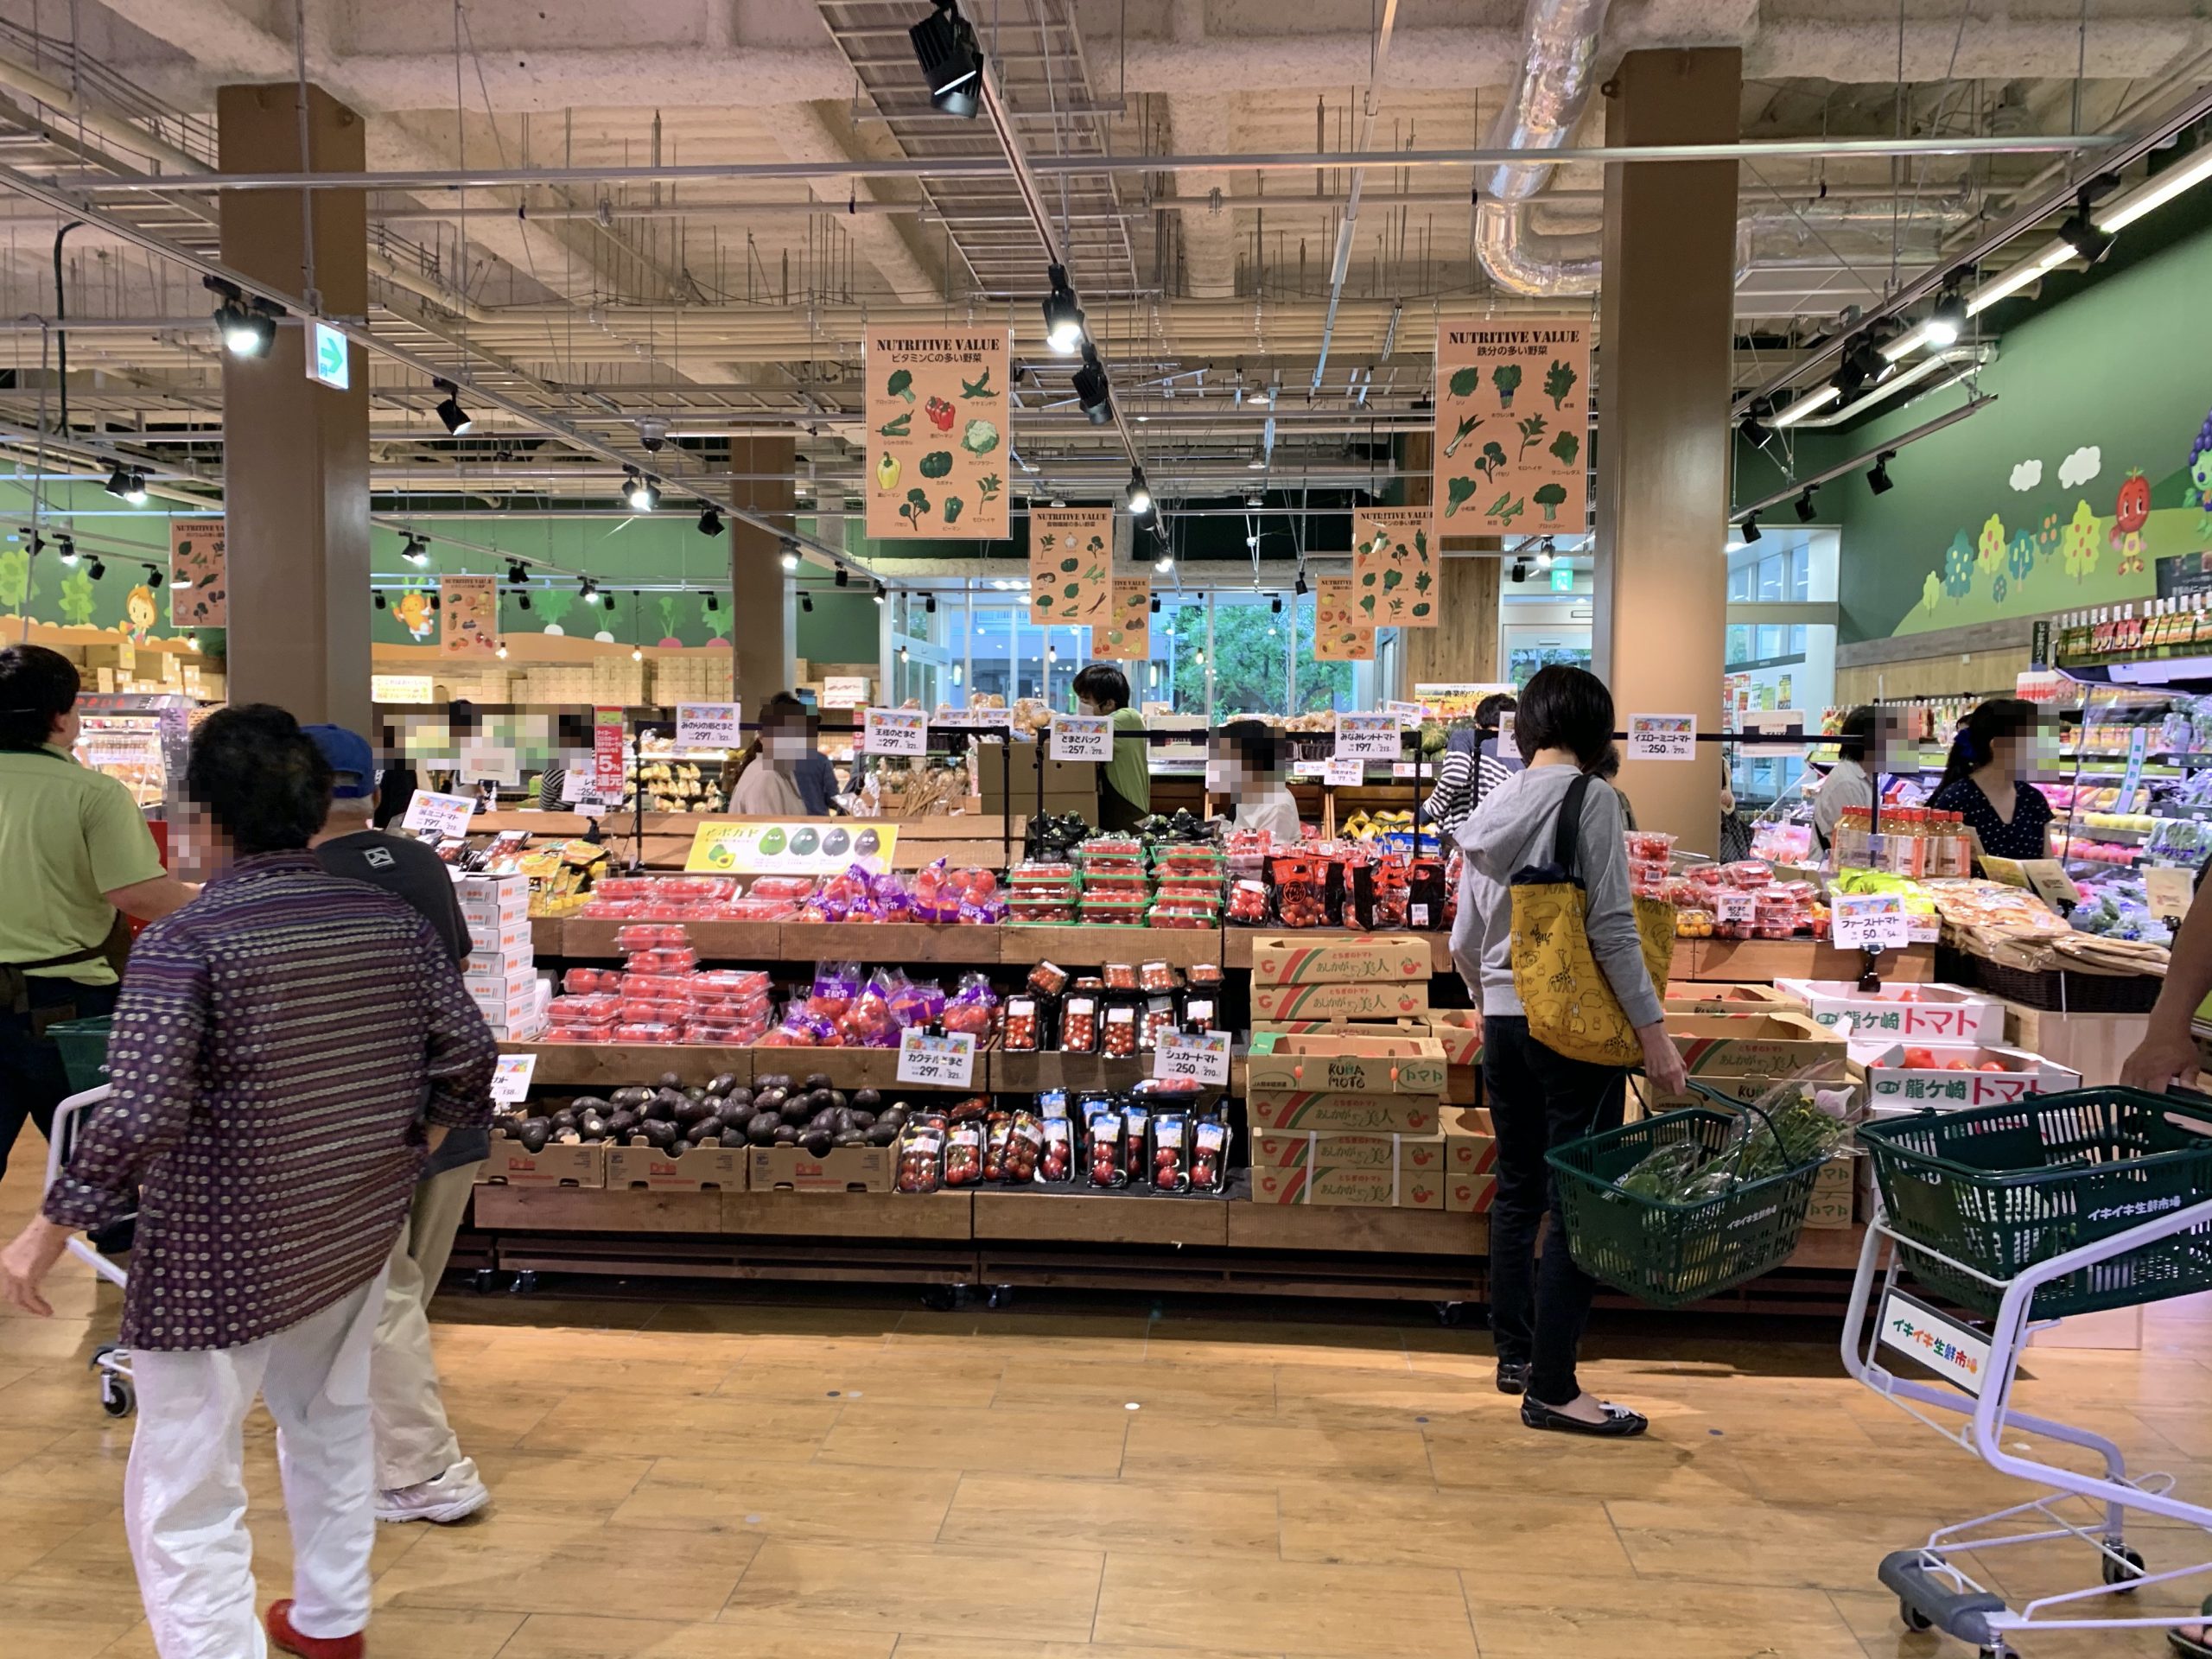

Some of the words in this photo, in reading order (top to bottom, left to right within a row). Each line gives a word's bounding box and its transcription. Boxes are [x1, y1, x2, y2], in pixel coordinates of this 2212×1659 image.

[1448, 332, 1529, 344] NUTRITIVE
[1532, 330, 1580, 343] VALUE
[877, 339, 952, 351] NUTRITIVE
[956, 339, 1000, 351] VALUE
[1477, 346, 1548, 356] 鉄分の多い野菜
[892, 353, 982, 363] ビタミンCの多い野菜
[883, 739, 899, 747] 297
[1635, 734, 1691, 743] イエローミニトマト
[1355, 743, 1371, 752] 197
[1649, 745, 1666, 753] 250
[424, 818, 441, 827] 197
[1842, 917, 1899, 928] ファーストトマト
[1863, 928, 1877, 938] 50
[1905, 1007, 1977, 1035] トマト
[1738, 1044, 1783, 1052] とちぎのトマト
[908, 1053, 963, 1066] カクテルとまと
[1166, 1050, 1218, 1063] シュガートマト
[919, 1066, 938, 1077] 297
[1176, 1063, 1196, 1074] 250
[1406, 1069, 1443, 1083] トマト
[1328, 1078, 1365, 1089] MOTO
[1905, 1078, 1967, 1099] 龍ケ崎
[1973, 1077, 2048, 1105] トマト
[508, 1158, 536, 1168] Dole
[650, 1162, 677, 1173] Dole
[796, 1163, 823, 1173] Dole
[1809, 1205, 1847, 1217] トマト
[2088, 1196, 2181, 1221] イキイキ生鮮市場
[1893, 1319, 1978, 1374] イキイキ生鮮市場
